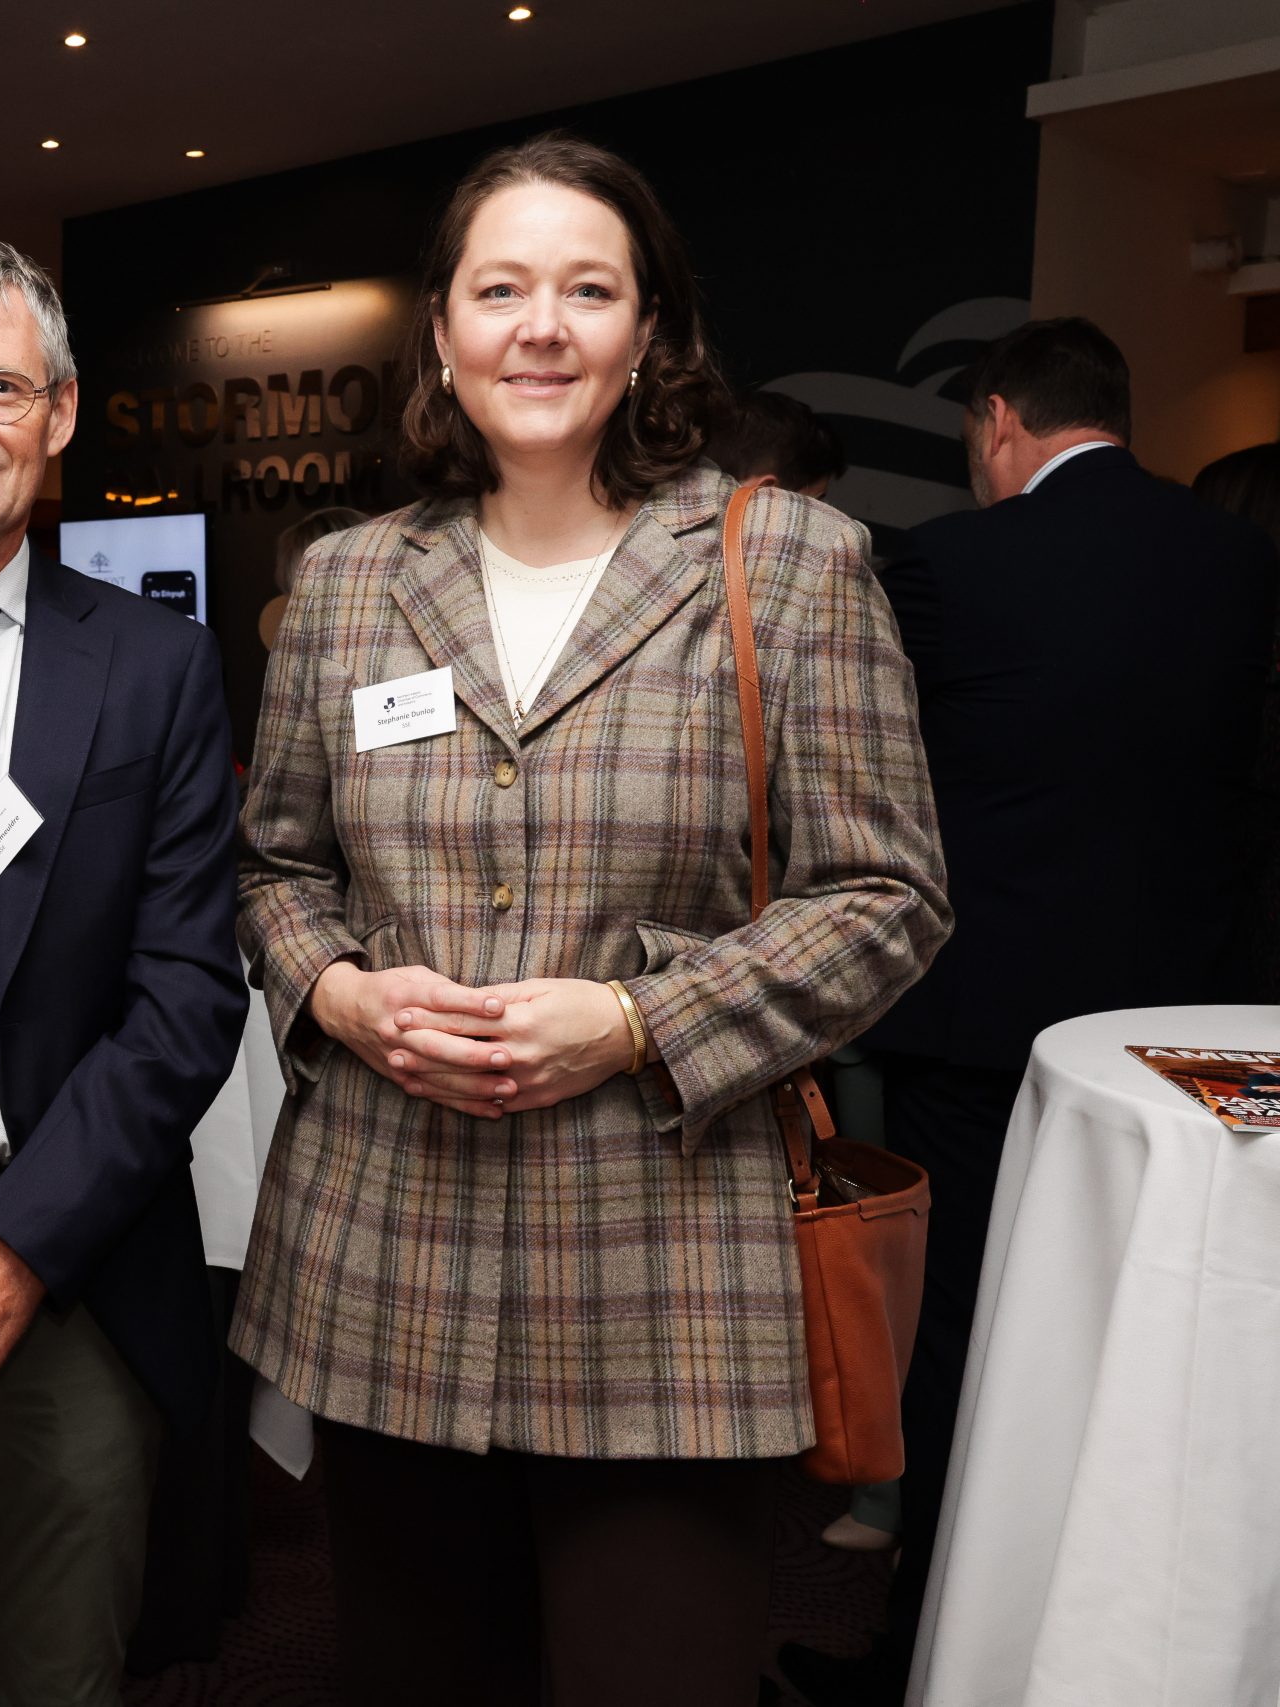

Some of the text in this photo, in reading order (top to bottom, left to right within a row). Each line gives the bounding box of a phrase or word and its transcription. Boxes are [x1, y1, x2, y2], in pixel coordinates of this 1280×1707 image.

[205, 336, 229, 359] TO
[236, 329, 273, 356] THE
[377, 707, 436, 726] Stephanie Dunlop
